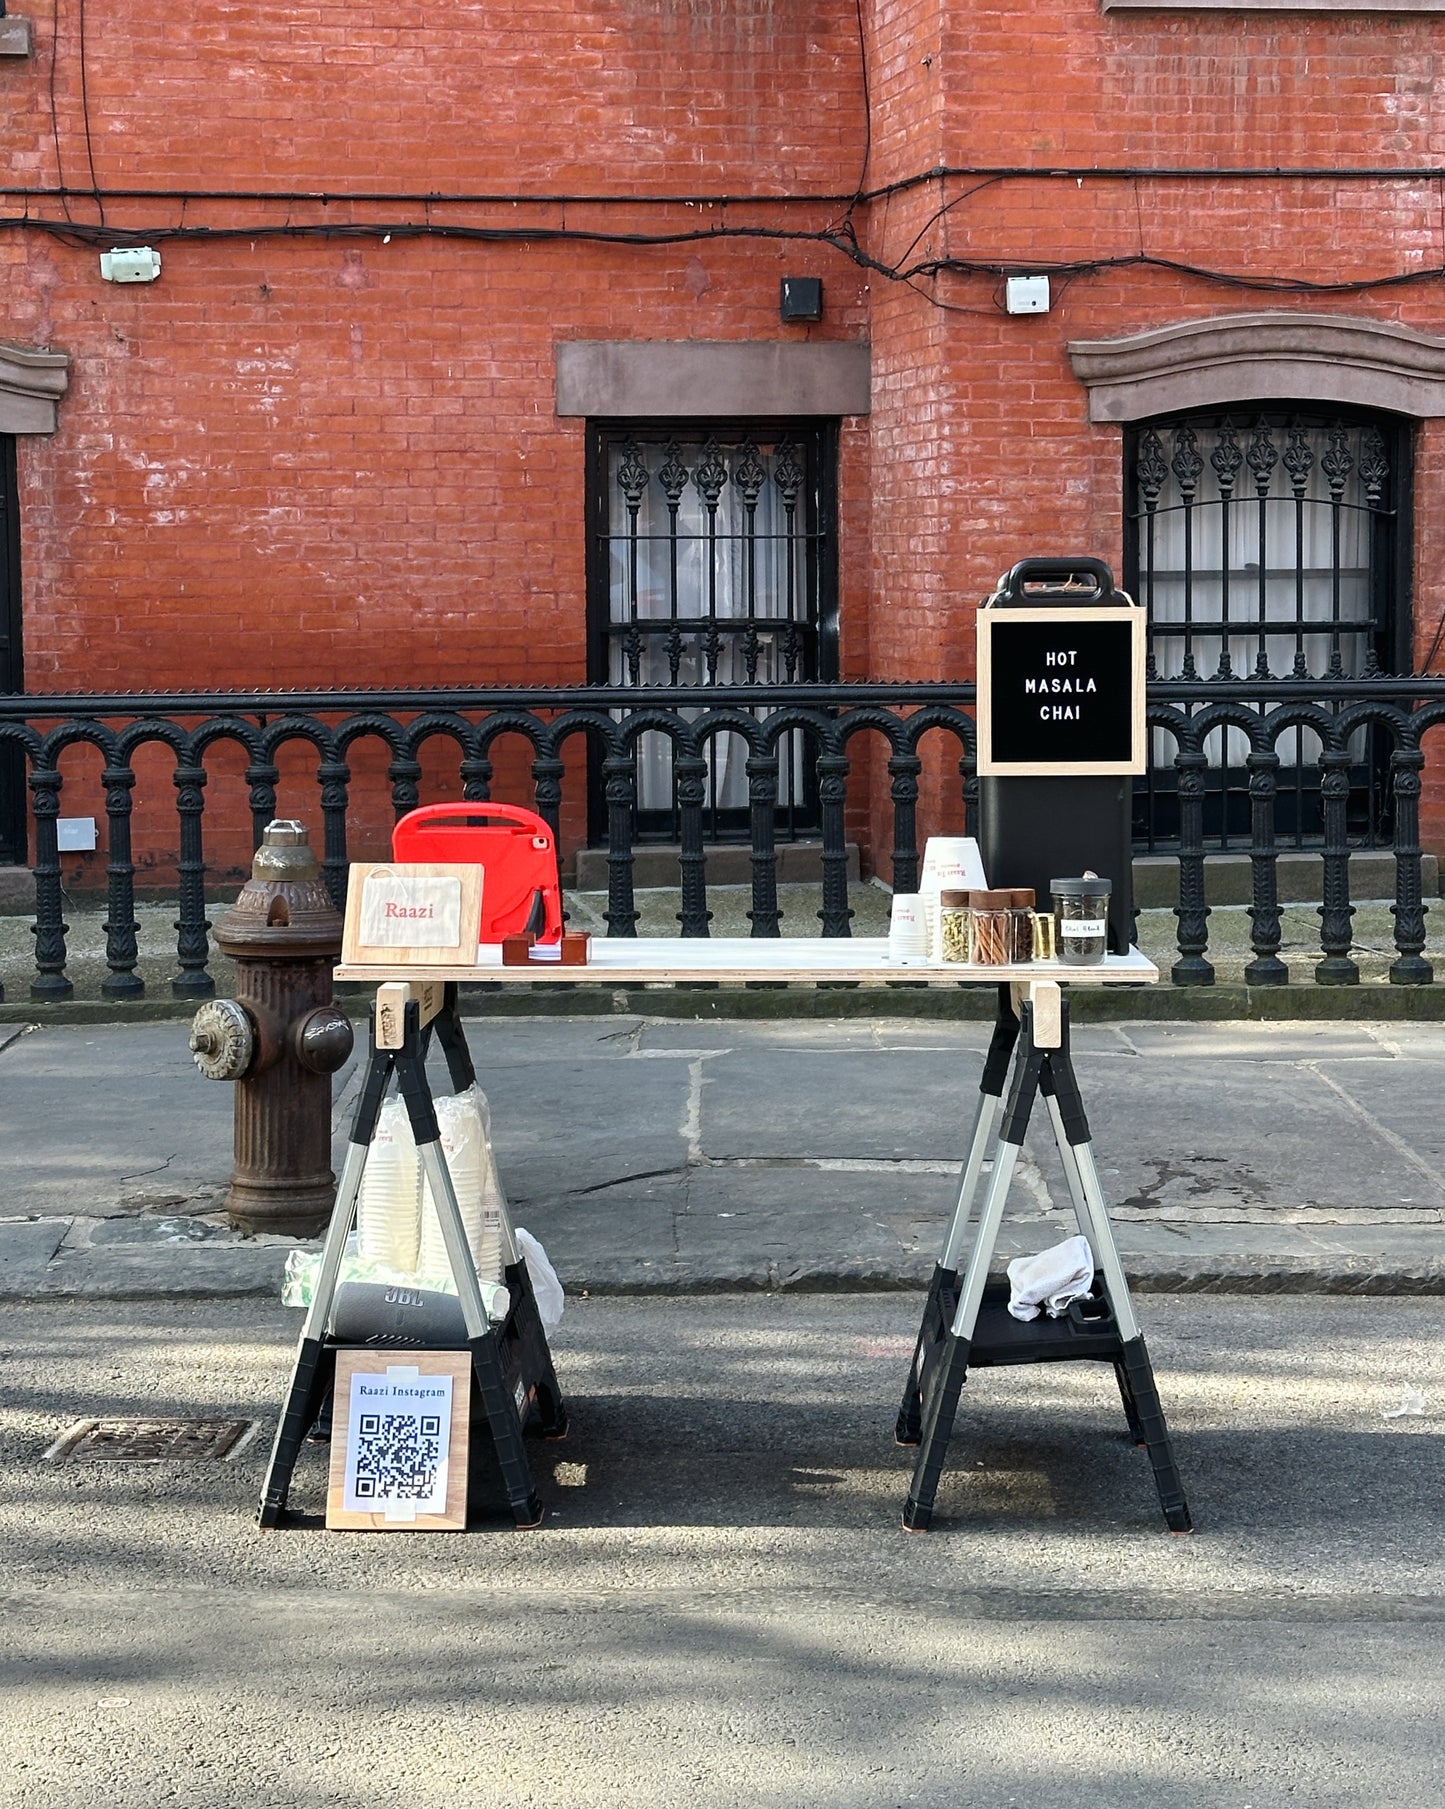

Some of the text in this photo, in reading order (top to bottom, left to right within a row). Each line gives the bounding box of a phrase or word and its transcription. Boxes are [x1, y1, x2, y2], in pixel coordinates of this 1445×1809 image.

[1046, 651, 1077, 666] HOT
[1025, 678, 1097, 693] MASALA
[1040, 705, 1081, 720] CHAI
[384, 902, 435, 919] Raazi
[384, 1286, 424, 1307] JBL
[359, 1385, 445, 1399] Raazi Instagram
